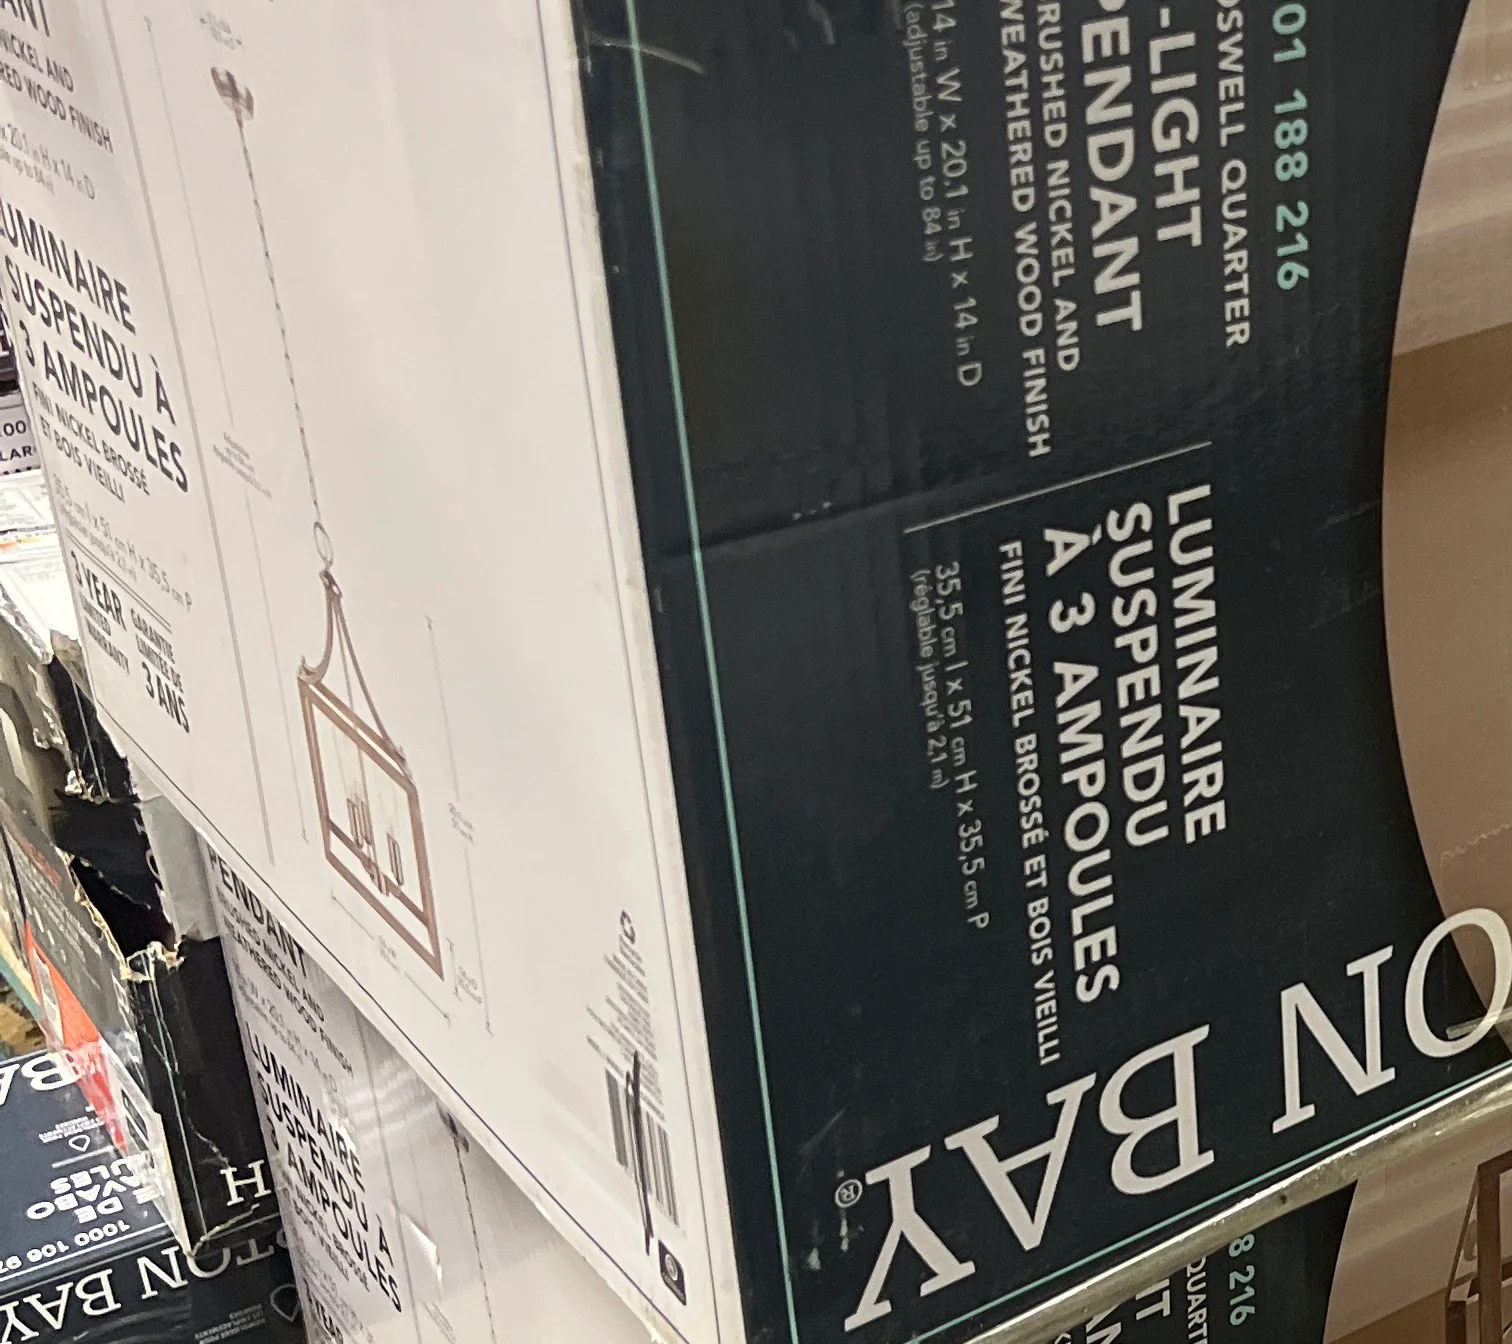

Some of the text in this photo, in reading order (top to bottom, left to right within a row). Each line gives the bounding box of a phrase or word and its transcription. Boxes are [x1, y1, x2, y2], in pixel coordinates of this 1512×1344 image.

[1274, 90, 1309, 182] 188
[1014, 223, 1044, 337] WOOD
[1046, 159, 1076, 287] NICKEL
[1219, 159, 1251, 347] QUARTER
[1275, 201, 1310, 291] 216
[5, 255, 176, 427] SUSPENDU À
[19, 319, 35, 367] 3
[42, 340, 188, 493] AMPOULES
[1022, 347, 1052, 458] FINISH
[1053, 298, 1080, 372] AND
[1106, 502, 1170, 847] SUSPENDU
[1165, 484, 1226, 844] LUMINAIRE
[1000, 540, 1061, 1066] FINI NICKEL BROSSÉ ET BOIS VIEILLI
[1044, 522, 1120, 1003] À 3 AMPOULES
[245, 1021, 366, 1193] LUMINAIRE
[256, 1071, 369, 1228] SUSPENDU
[844, 1024, 1217, 1332] BAY
[285, 1152, 402, 1312] AMPOULES
[1229, 1265, 1255, 1326] 216
